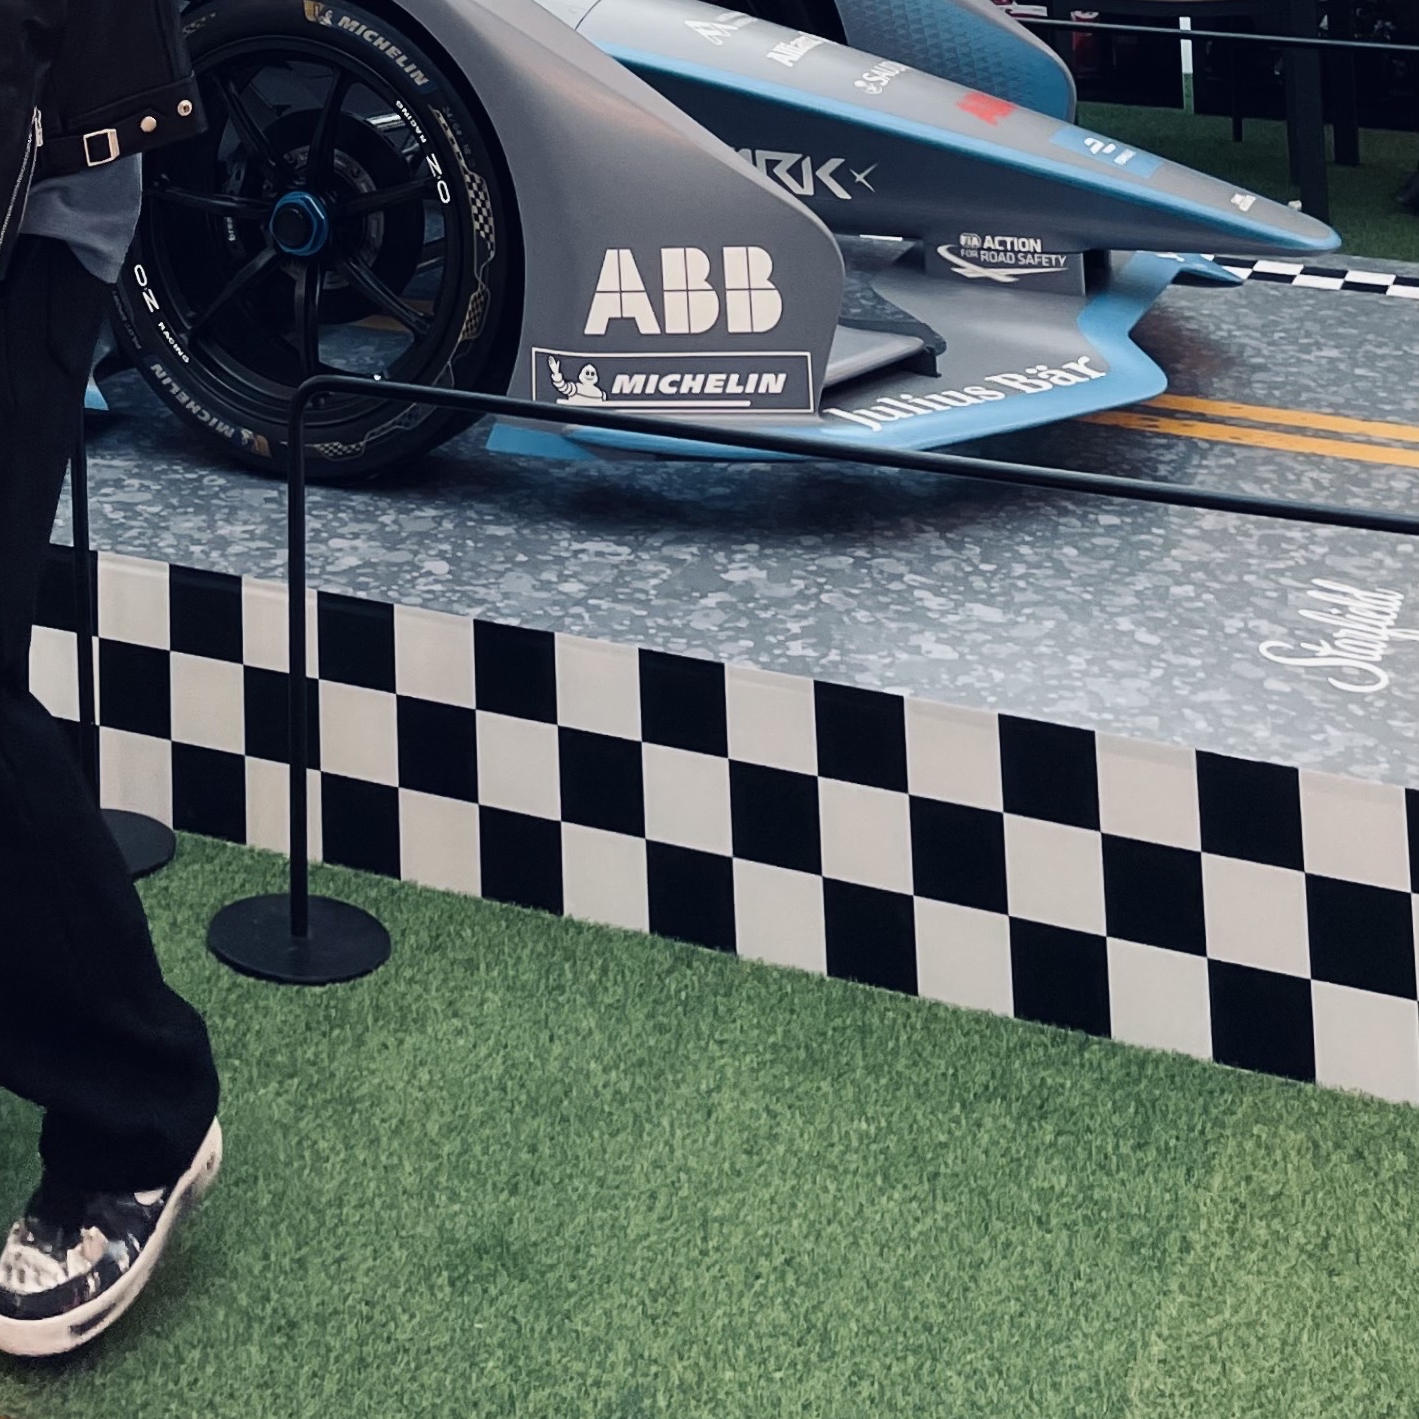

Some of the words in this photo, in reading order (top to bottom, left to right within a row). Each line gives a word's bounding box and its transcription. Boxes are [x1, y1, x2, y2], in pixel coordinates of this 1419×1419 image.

[338, 15, 430, 87] MICHELIN
[395, 100, 427, 144] RACING
[960, 248, 978, 258] FOR
[980, 250, 1016, 264] ROAD
[1017, 253, 1067, 267] SAFETY
[982, 234, 1042, 253] ACTION
[583, 246, 783, 335] ABB
[157, 321, 190, 364] RACING
[150, 363, 236, 438] MICHELIN
[610, 372, 787, 395] MICHELIN
[820, 376, 1006, 433] Julius
[1001, 353, 1108, 396] Bär
